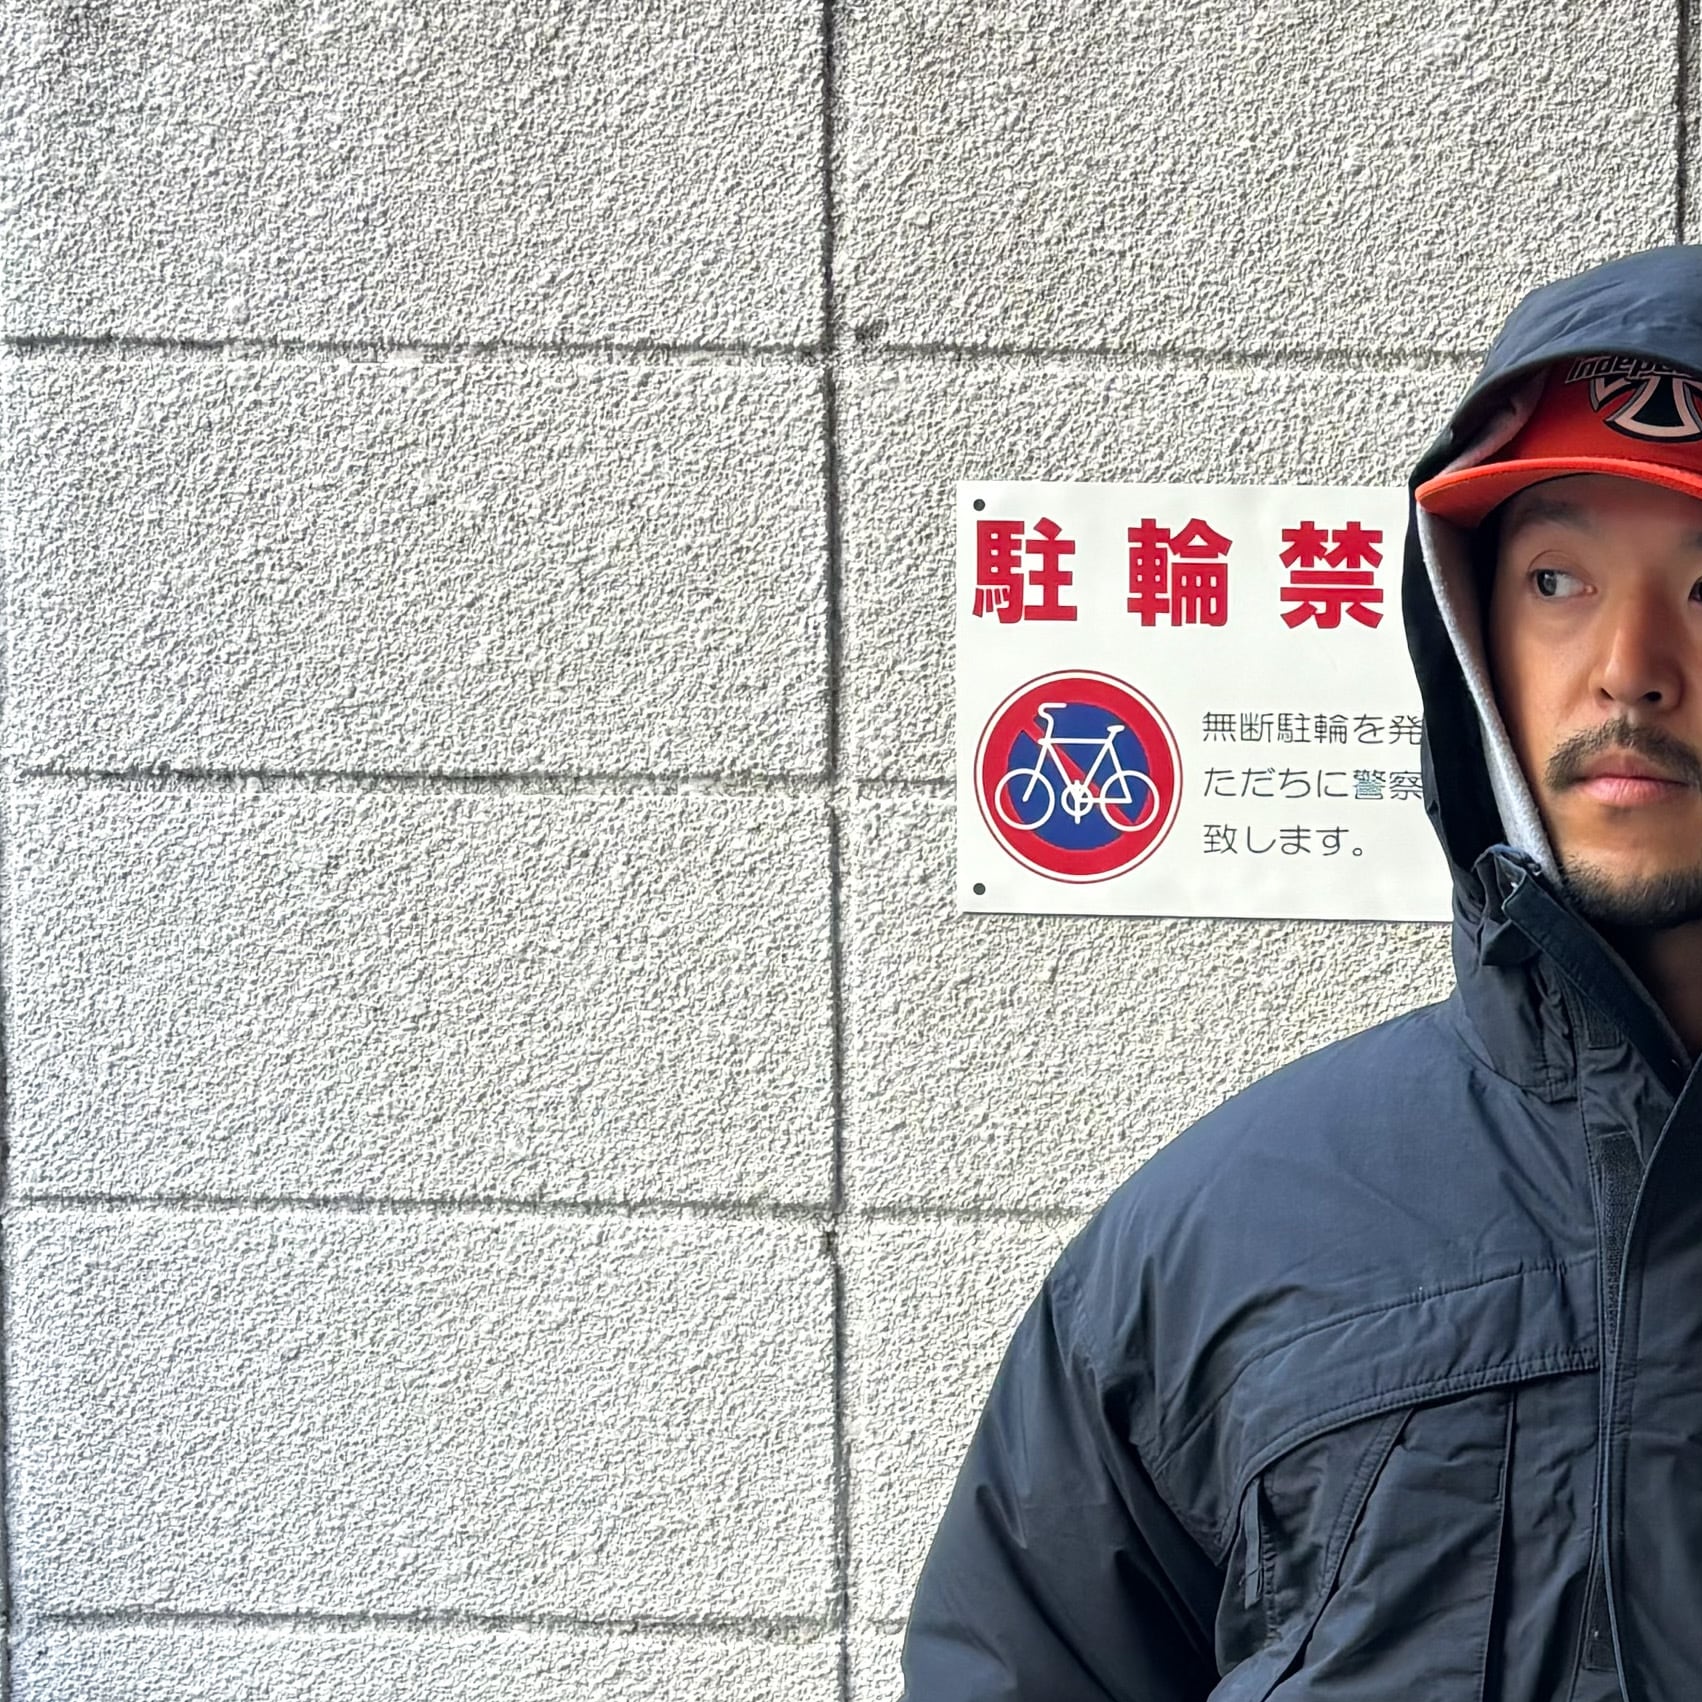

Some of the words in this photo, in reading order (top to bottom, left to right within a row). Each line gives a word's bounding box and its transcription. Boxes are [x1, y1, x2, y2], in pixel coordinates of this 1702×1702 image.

[1202, 712, 1423, 745] 無断駐輪を発
[1204, 767, 1423, 801] ただちに警察
[1203, 824, 1363, 856] 致します。
